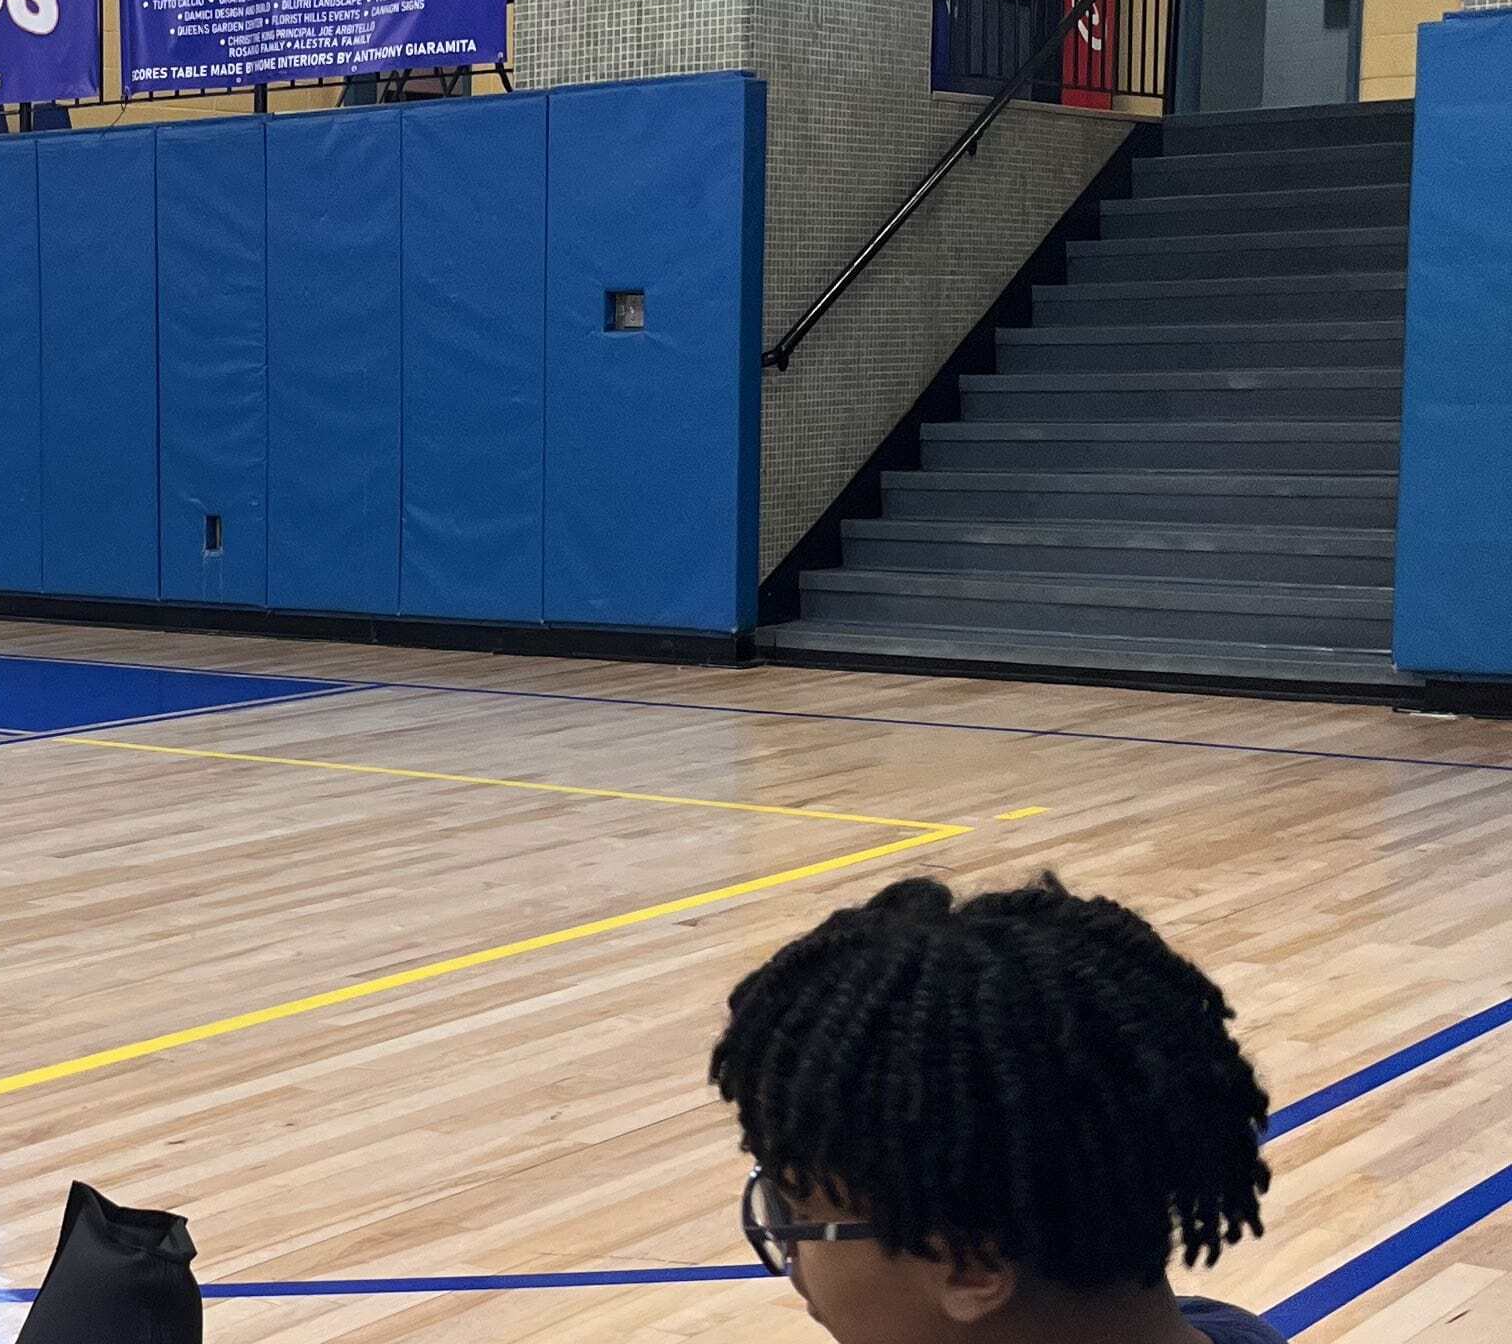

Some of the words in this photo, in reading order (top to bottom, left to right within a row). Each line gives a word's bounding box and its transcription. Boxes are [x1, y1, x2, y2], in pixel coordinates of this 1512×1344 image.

[177, 24, 209, 36] QUEENS
[212, 21, 244, 33] GARDEN
[271, 13, 303, 25] FLORIST
[304, 11, 327, 23] HILLS
[328, 8, 361, 22] EVENTS
[214, 7, 244, 19] DESIGN
[260, 40, 286, 54] FAMILY
[294, 35, 338, 49] ALESTRA
[341, 32, 373, 46] FAMILY
[275, 26, 316, 39] PRINCIPAL
[318, 25, 334, 36] JOE
[171, 65, 207, 78] TABLE
[210, 63, 243, 76] MADE
[277, 53, 334, 69] INTERIORS
[336, 51, 352, 63] BY
[354, 45, 402, 63] ANTHONY
[405, 39, 477, 57] GIARAMITA
